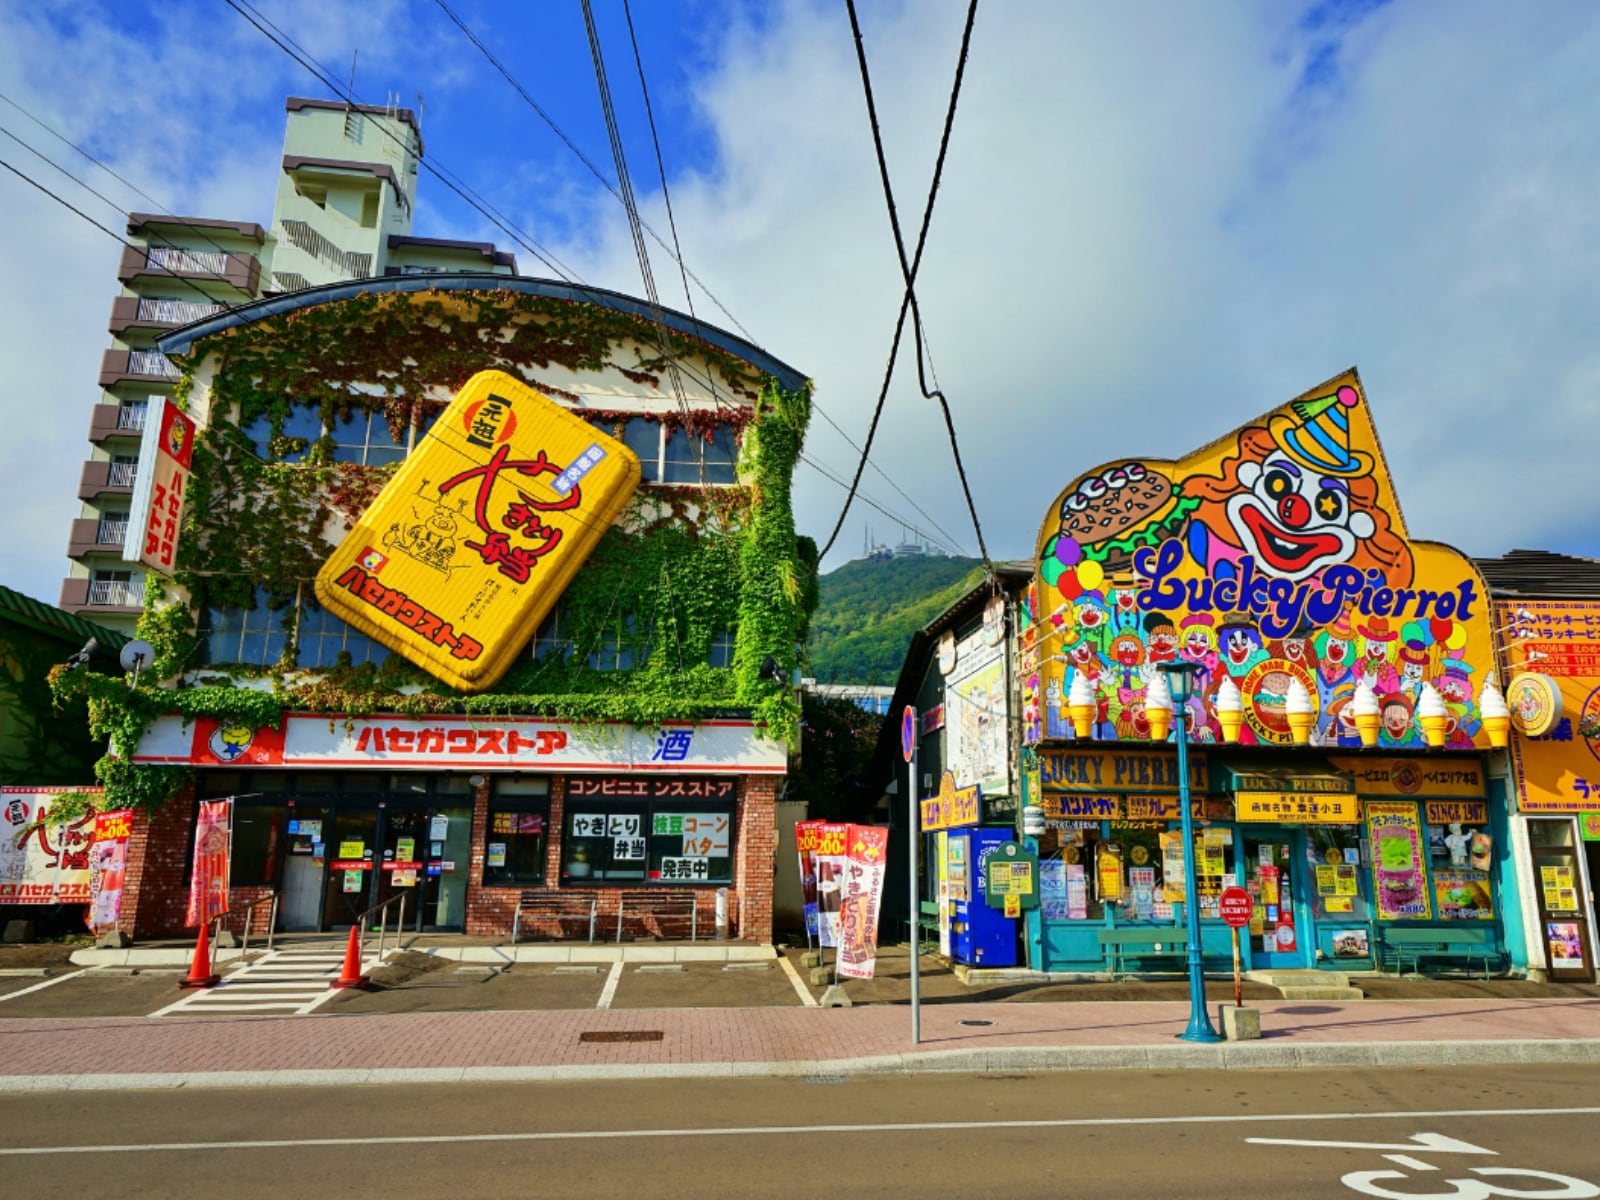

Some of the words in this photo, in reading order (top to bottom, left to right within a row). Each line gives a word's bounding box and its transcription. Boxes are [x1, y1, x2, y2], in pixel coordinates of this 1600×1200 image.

[471, 401, 504, 442] 元祖
[1133, 540, 1313, 639] Lucky
[1307, 563, 1477, 624] Pierrot
[333, 564, 484, 661] ハセガワストア
[1243, 669, 1260, 695] HOME
[1260, 660, 1285, 672] MADE
[1288, 662, 1317, 697] BURGER
[1244, 706, 1275, 741] LUCKY
[355, 727, 567, 755] ハセガワストア
[652, 728, 693, 761] 酒
[256, 752, 270, 763] 24
[1041, 753, 1104, 784] LUCKY
[1113, 756, 1206, 787] PIERRT
[569, 779, 733, 797] コンビニエンスストア
[1429, 803, 1460, 821] SINCE
[575, 816, 639, 836] やきとり
[654, 815, 683, 835] 枝豆
[684, 815, 729, 834] コーン
[615, 840, 645, 858] 弁当
[684, 837, 729, 856] バター
[662, 858, 708, 878] 発売中
